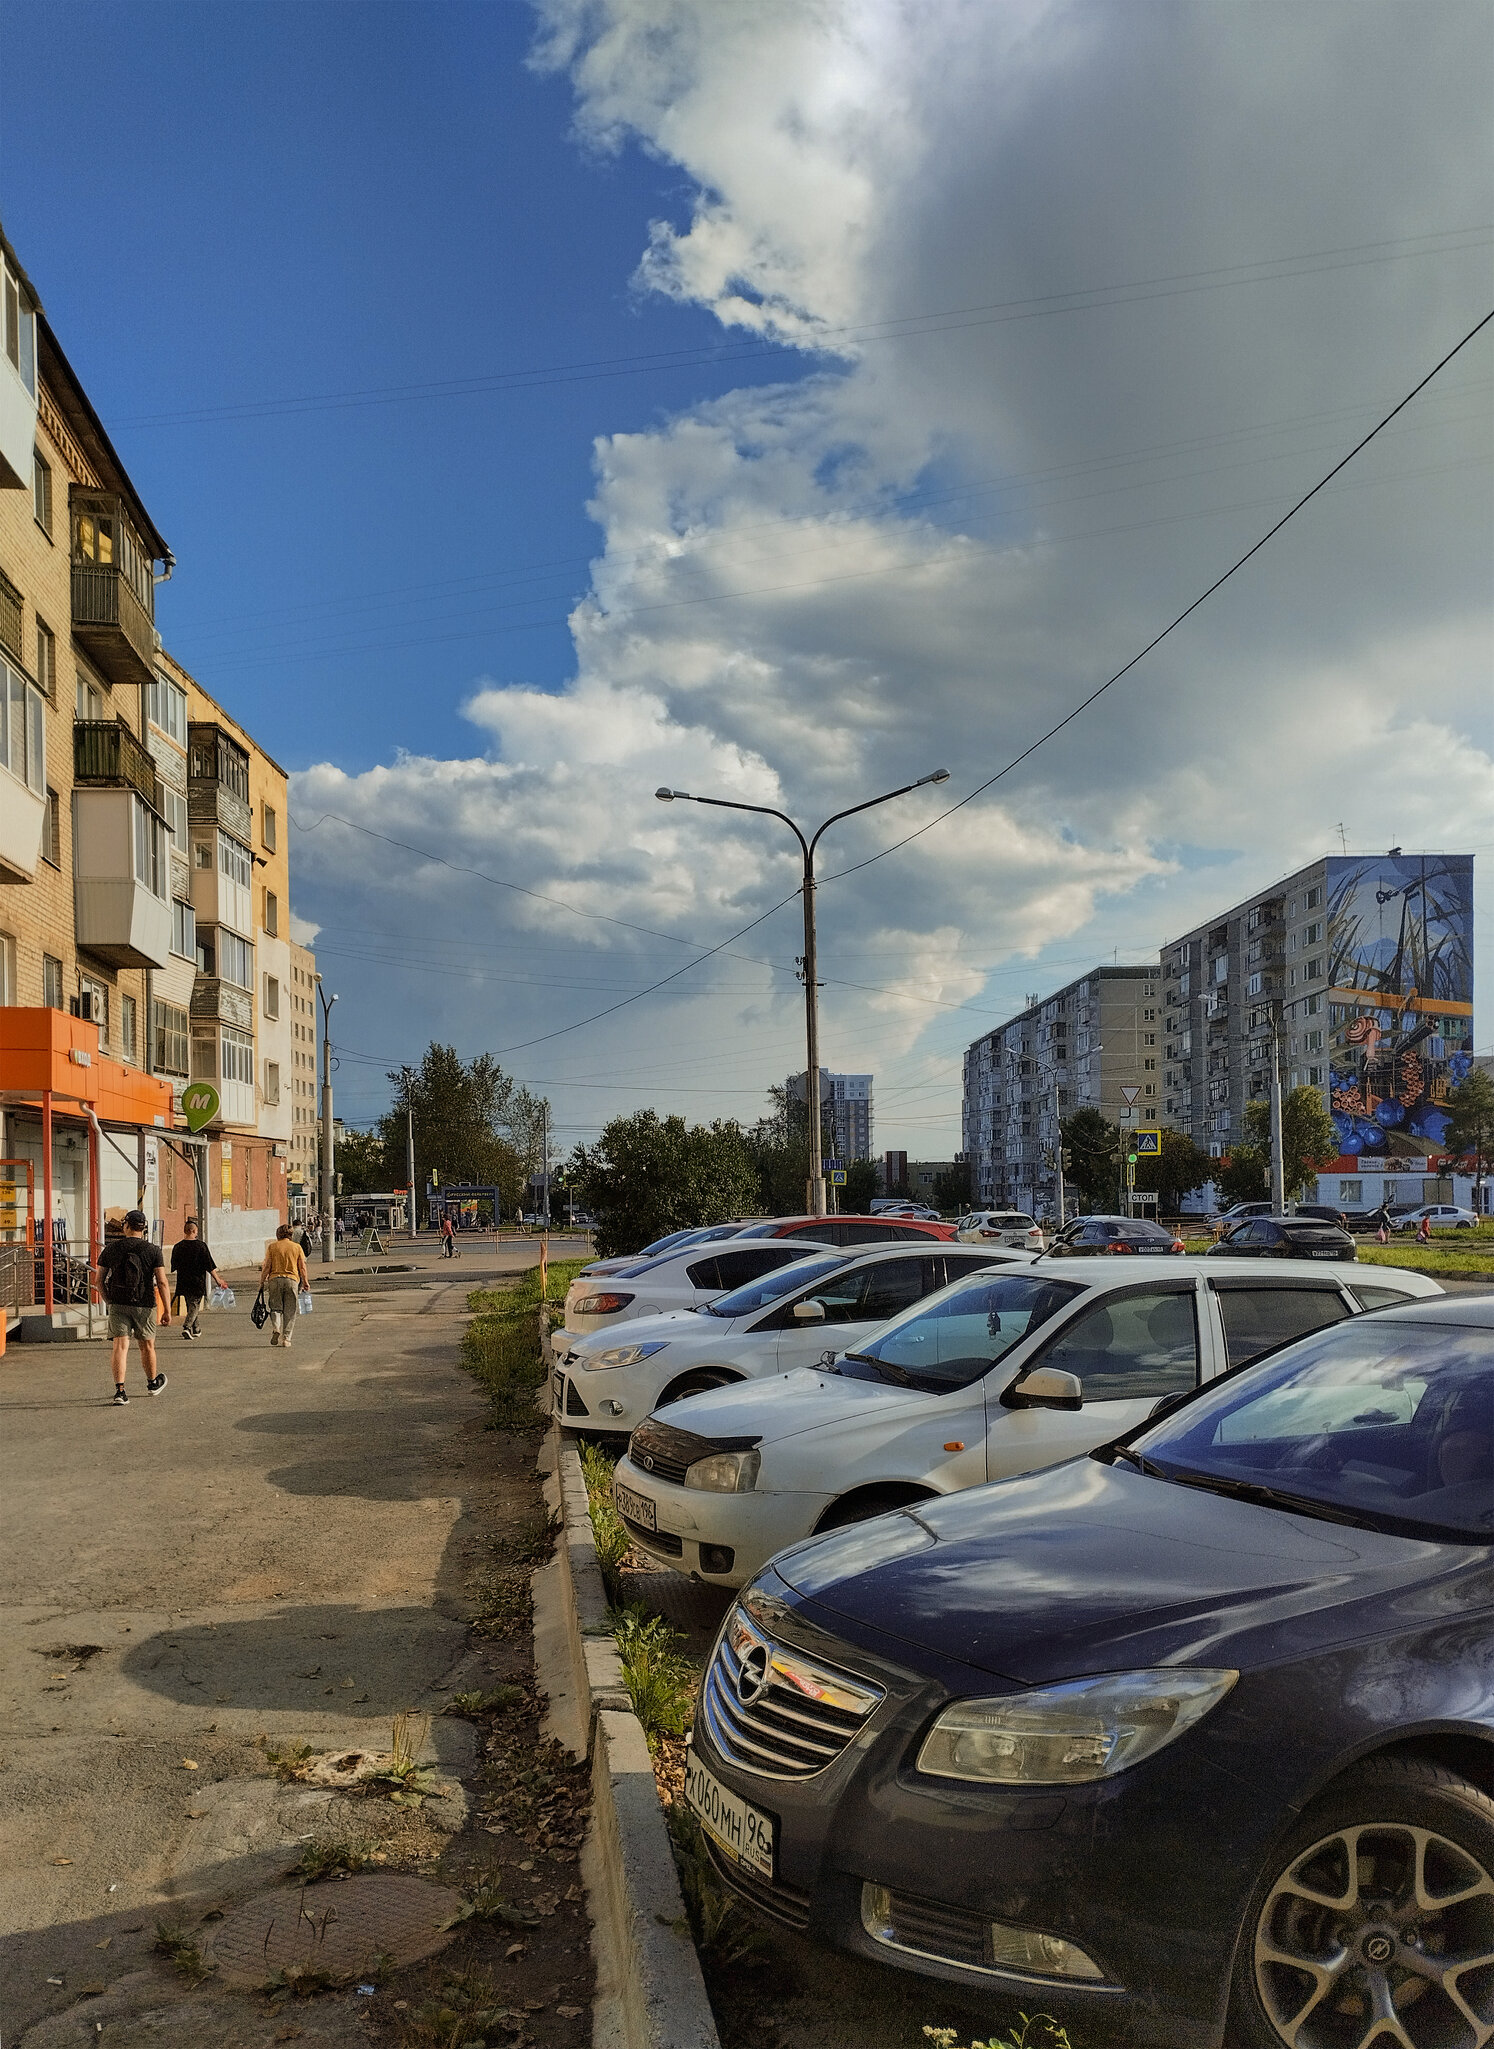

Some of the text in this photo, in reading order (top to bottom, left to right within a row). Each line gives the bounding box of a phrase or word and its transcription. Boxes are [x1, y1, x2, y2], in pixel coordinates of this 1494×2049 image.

[1131, 1194, 1154, 1202] СТОП
[747, 1812, 766, 1851] 96
[745, 1842, 760, 1862] RUS
